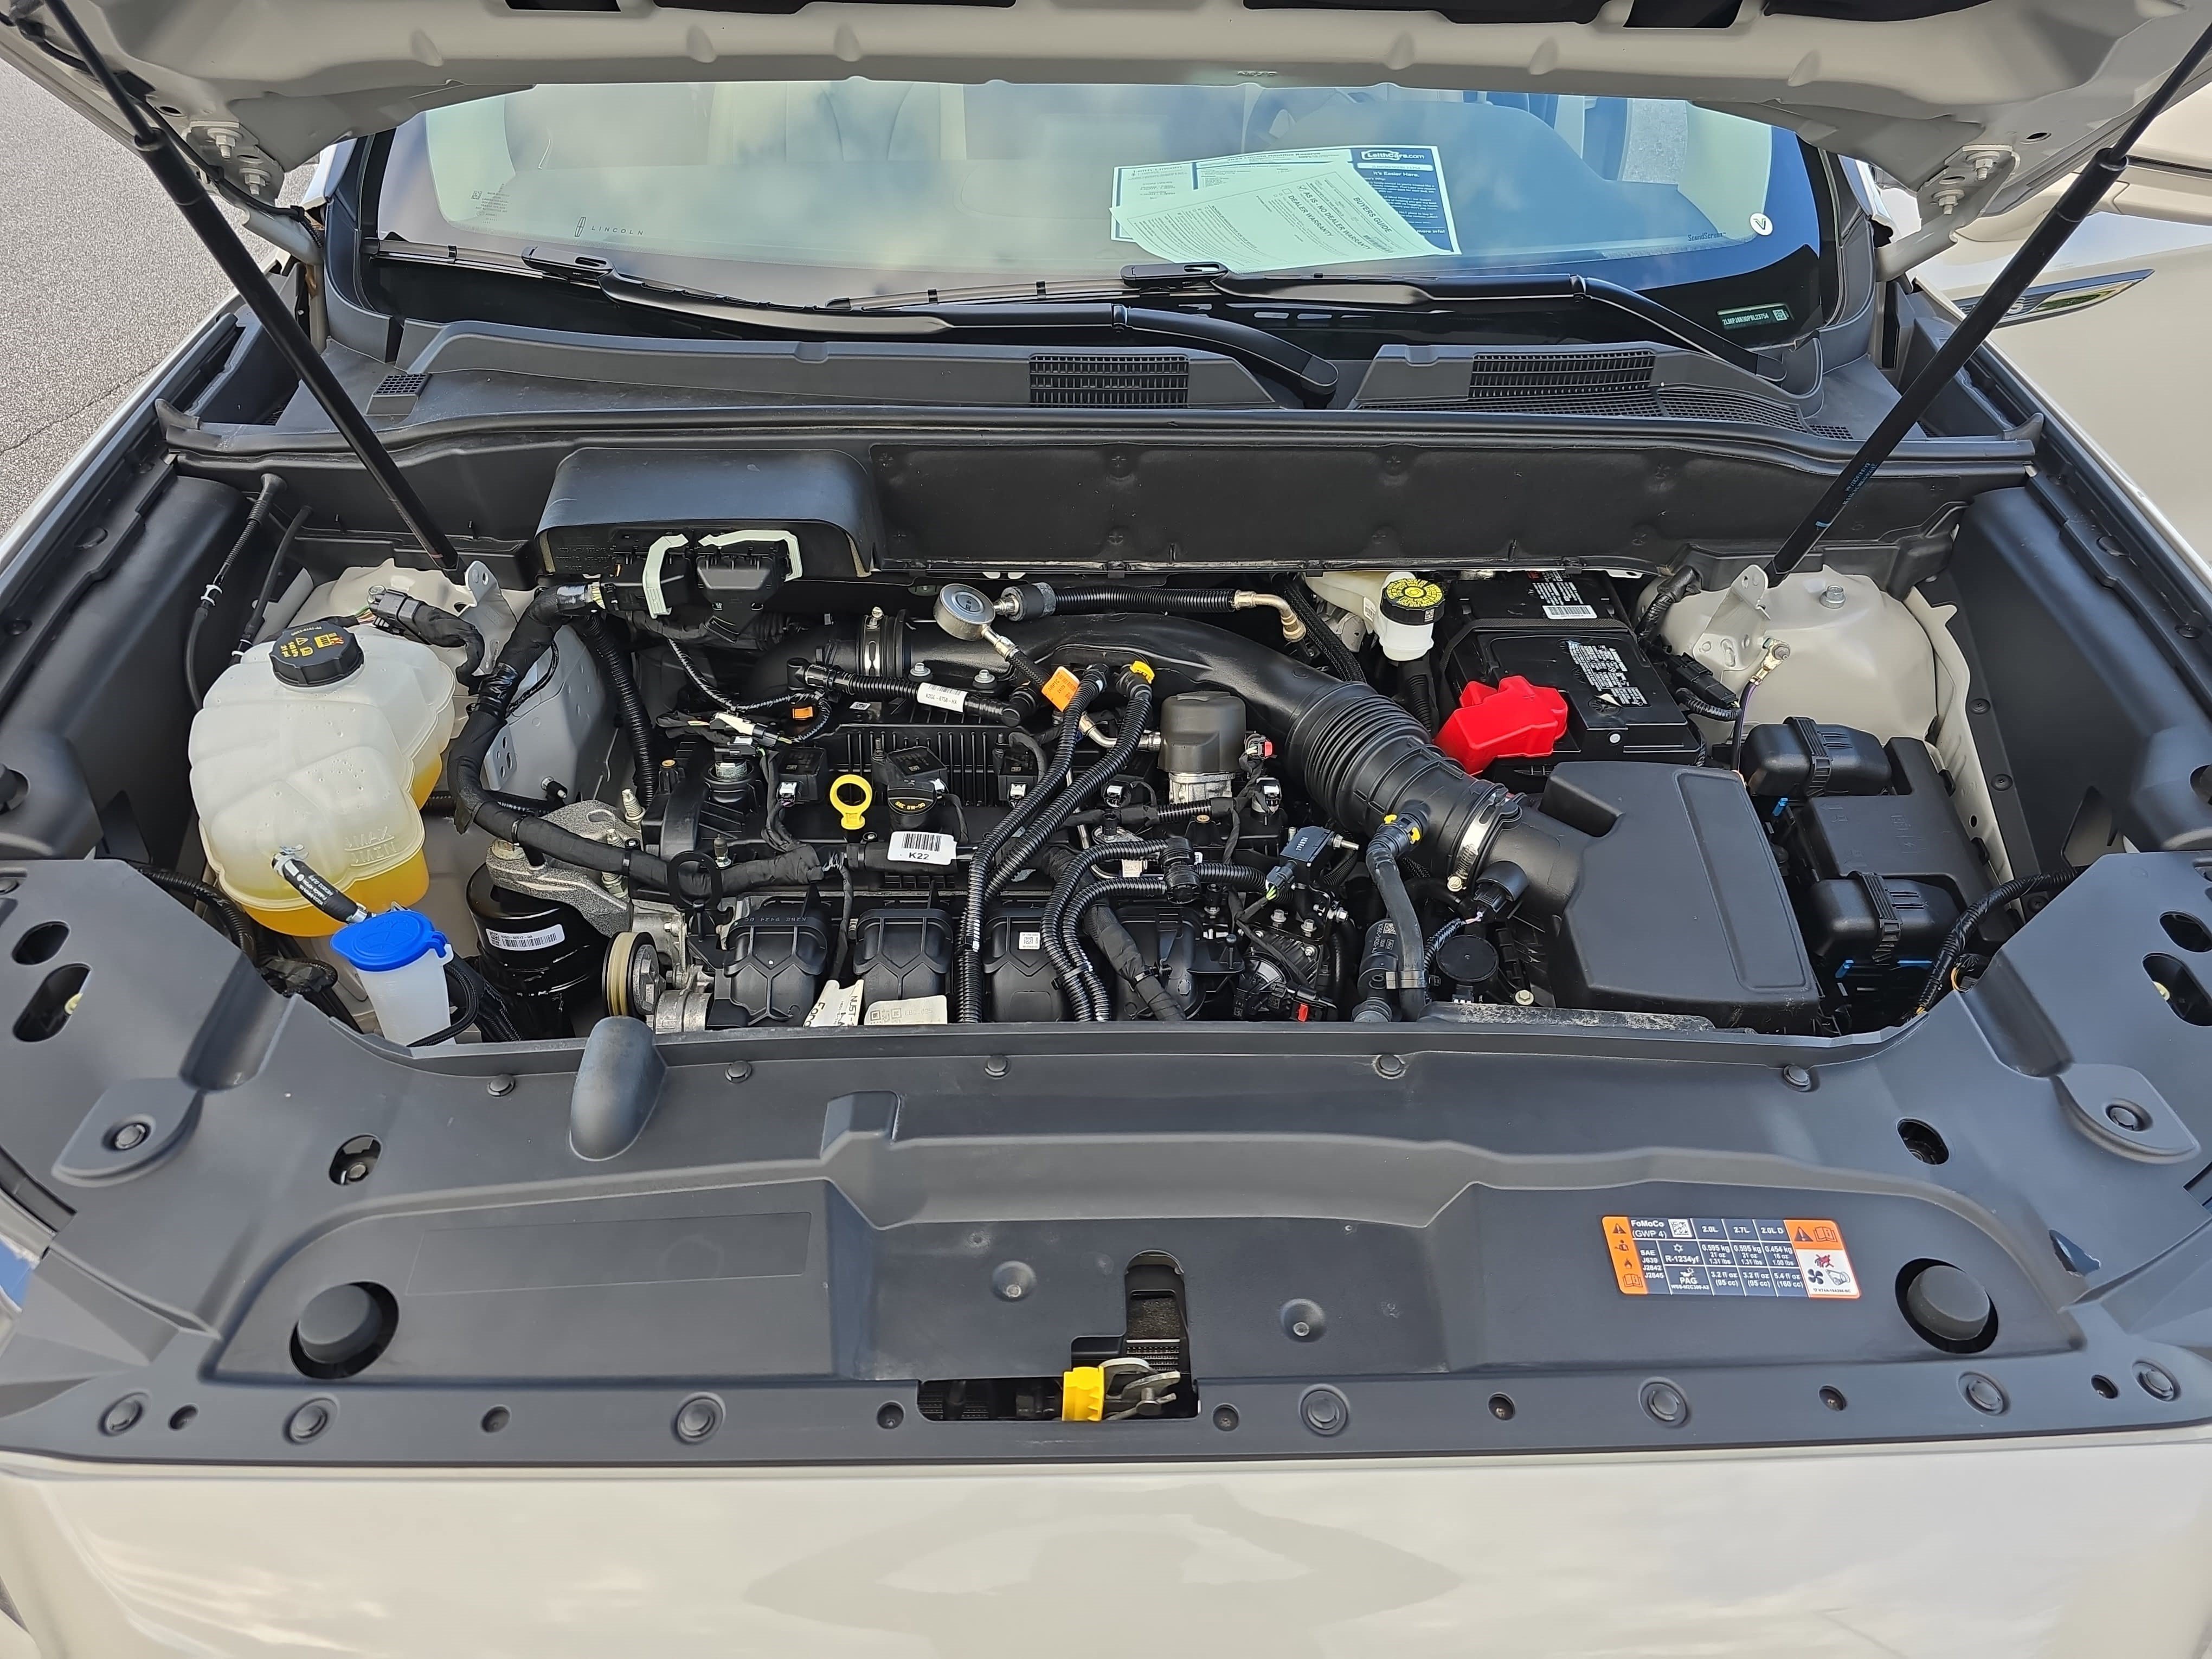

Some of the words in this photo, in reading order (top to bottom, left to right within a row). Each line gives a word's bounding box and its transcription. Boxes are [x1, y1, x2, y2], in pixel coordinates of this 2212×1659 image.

[1288, 194, 1308, 214] DEALER
[1306, 213, 1334, 237] WARRANTY
[1353, 197, 1376, 218] BUYERS
[1374, 215, 1392, 233] GUIDE
[1303, 190, 1313, 200] AS
[1317, 204, 1327, 214] NO
[1324, 211, 1345, 231] DEALER
[1342, 227, 1372, 250] WARRANTY
[591, 226, 644, 236] LINCOLN
[895, 801, 906, 809] SAE
[906, 802, 926, 811] 5W-30
[909, 852, 929, 860] K22
[1632, 1230, 1656, 1239] (GWP
[1658, 1230, 1667, 1239] 4)
[1721, 1245, 1730, 1253] kg
[1753, 1245, 1761, 1253] kg
[1784, 1246, 1793, 1254] kg
[1665, 1255, 1700, 1264] R-1234yf
